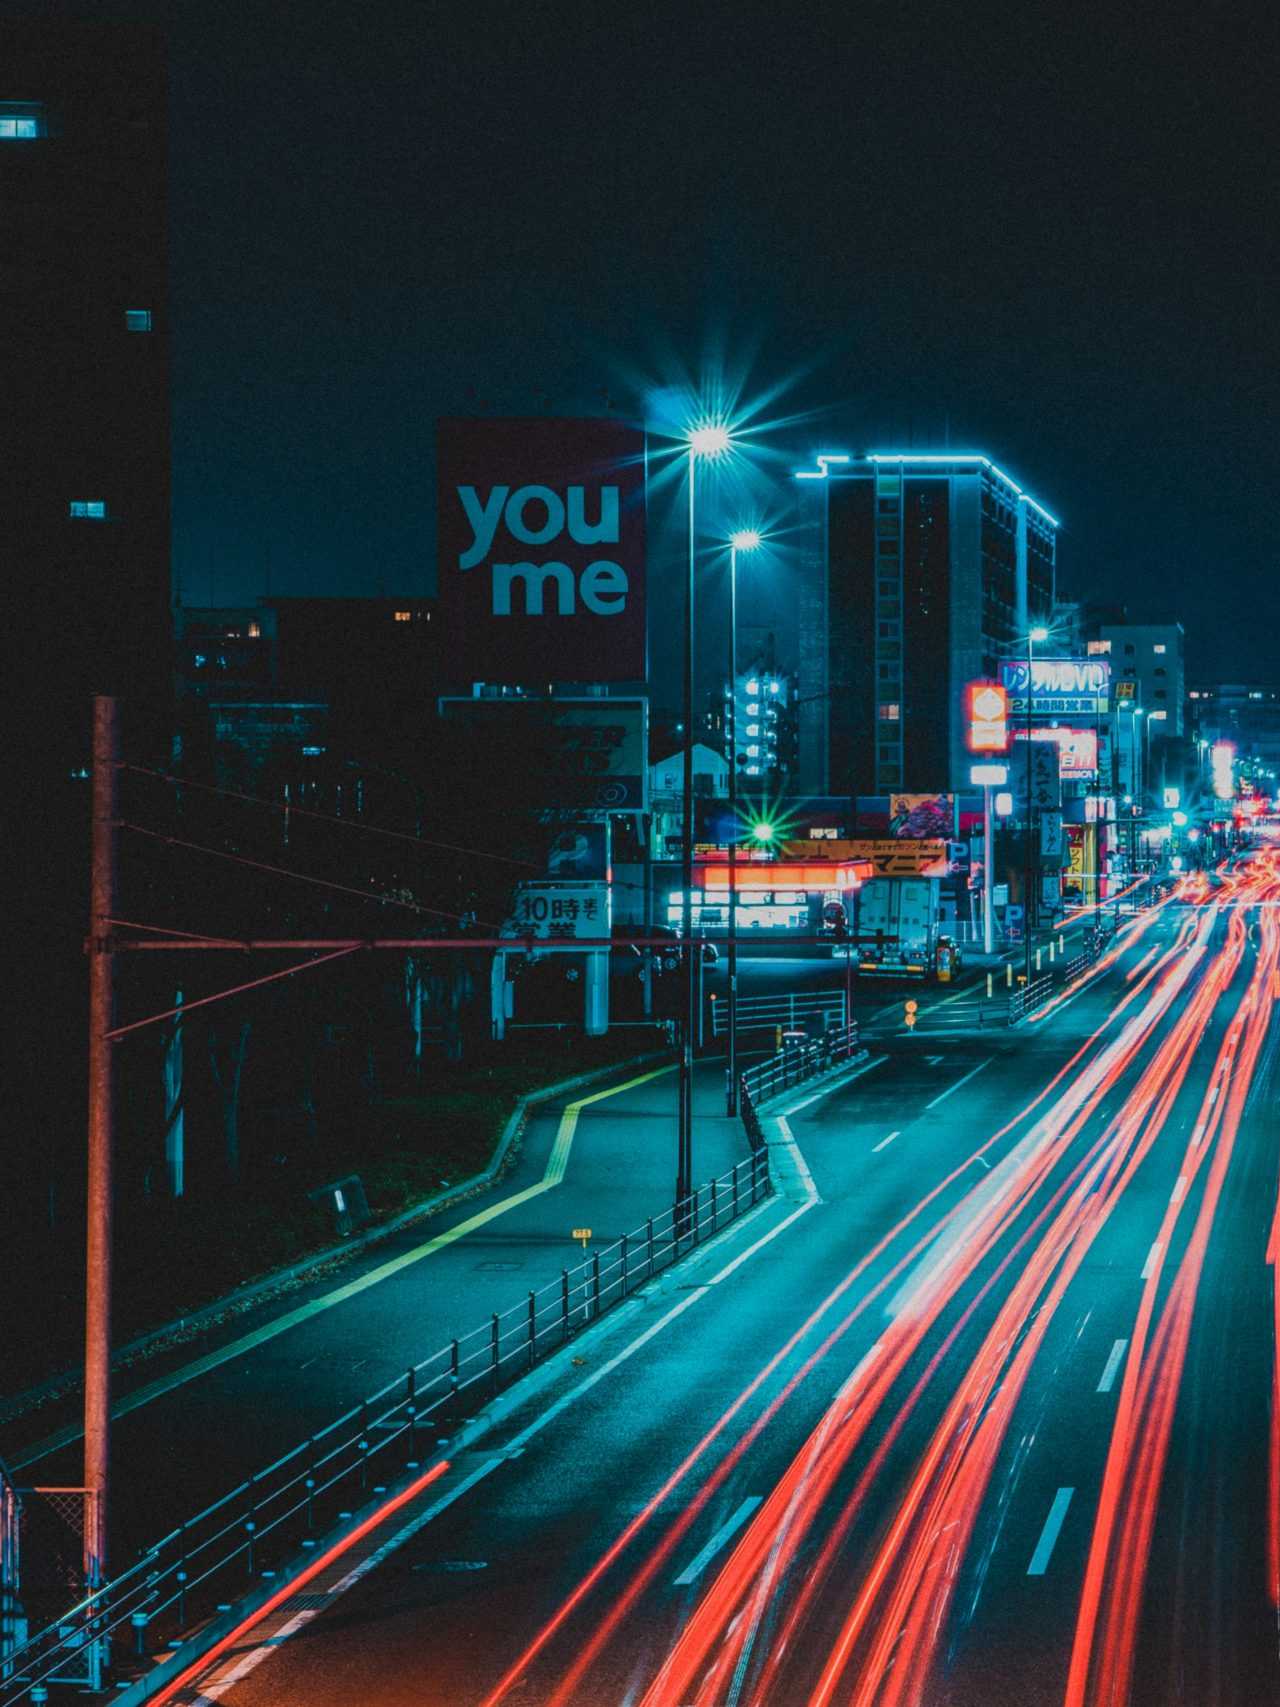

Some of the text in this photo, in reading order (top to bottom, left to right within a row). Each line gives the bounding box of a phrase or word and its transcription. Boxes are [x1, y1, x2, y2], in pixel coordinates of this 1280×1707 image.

[456, 484, 620, 571] you
[492, 560, 630, 616] me
[950, 843, 968, 861] P
[1005, 905, 1022, 925] P
